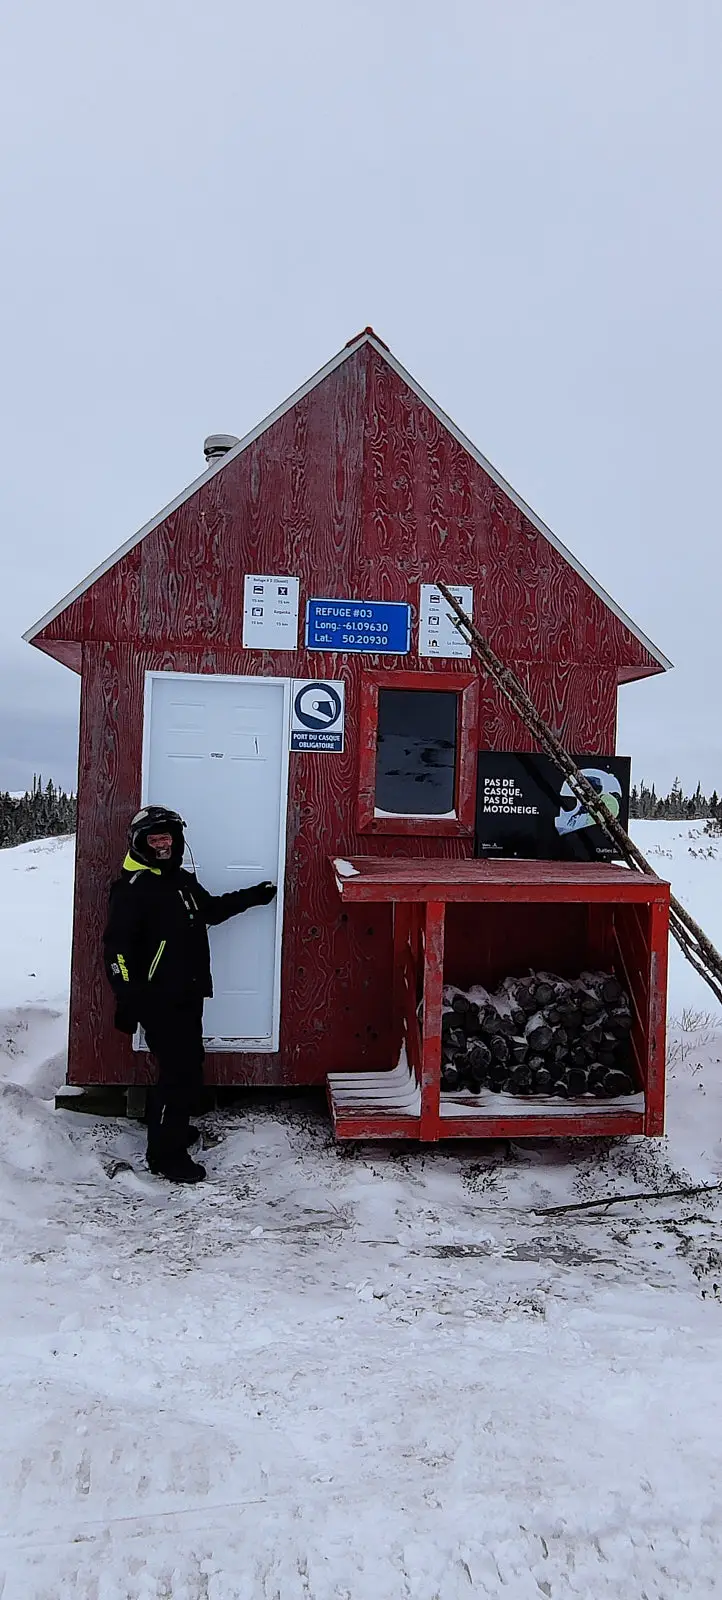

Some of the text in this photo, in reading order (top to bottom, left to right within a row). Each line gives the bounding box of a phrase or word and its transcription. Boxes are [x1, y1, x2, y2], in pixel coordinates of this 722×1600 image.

[315, 607, 373, 618] REFUGE #03
[342, 622, 388, 632] -61.09630
[342, 634, 388, 645] 50.20930
[318, 734, 341, 742] CASQUE
[298, 741, 335, 749] OBLIGATOIRE
[484, 778, 515, 787] PAS DE
[484, 787, 523, 798] CASQUE,
[484, 796, 514, 805] PAS DE
[483, 805, 540, 815] MOTONEIGE.
